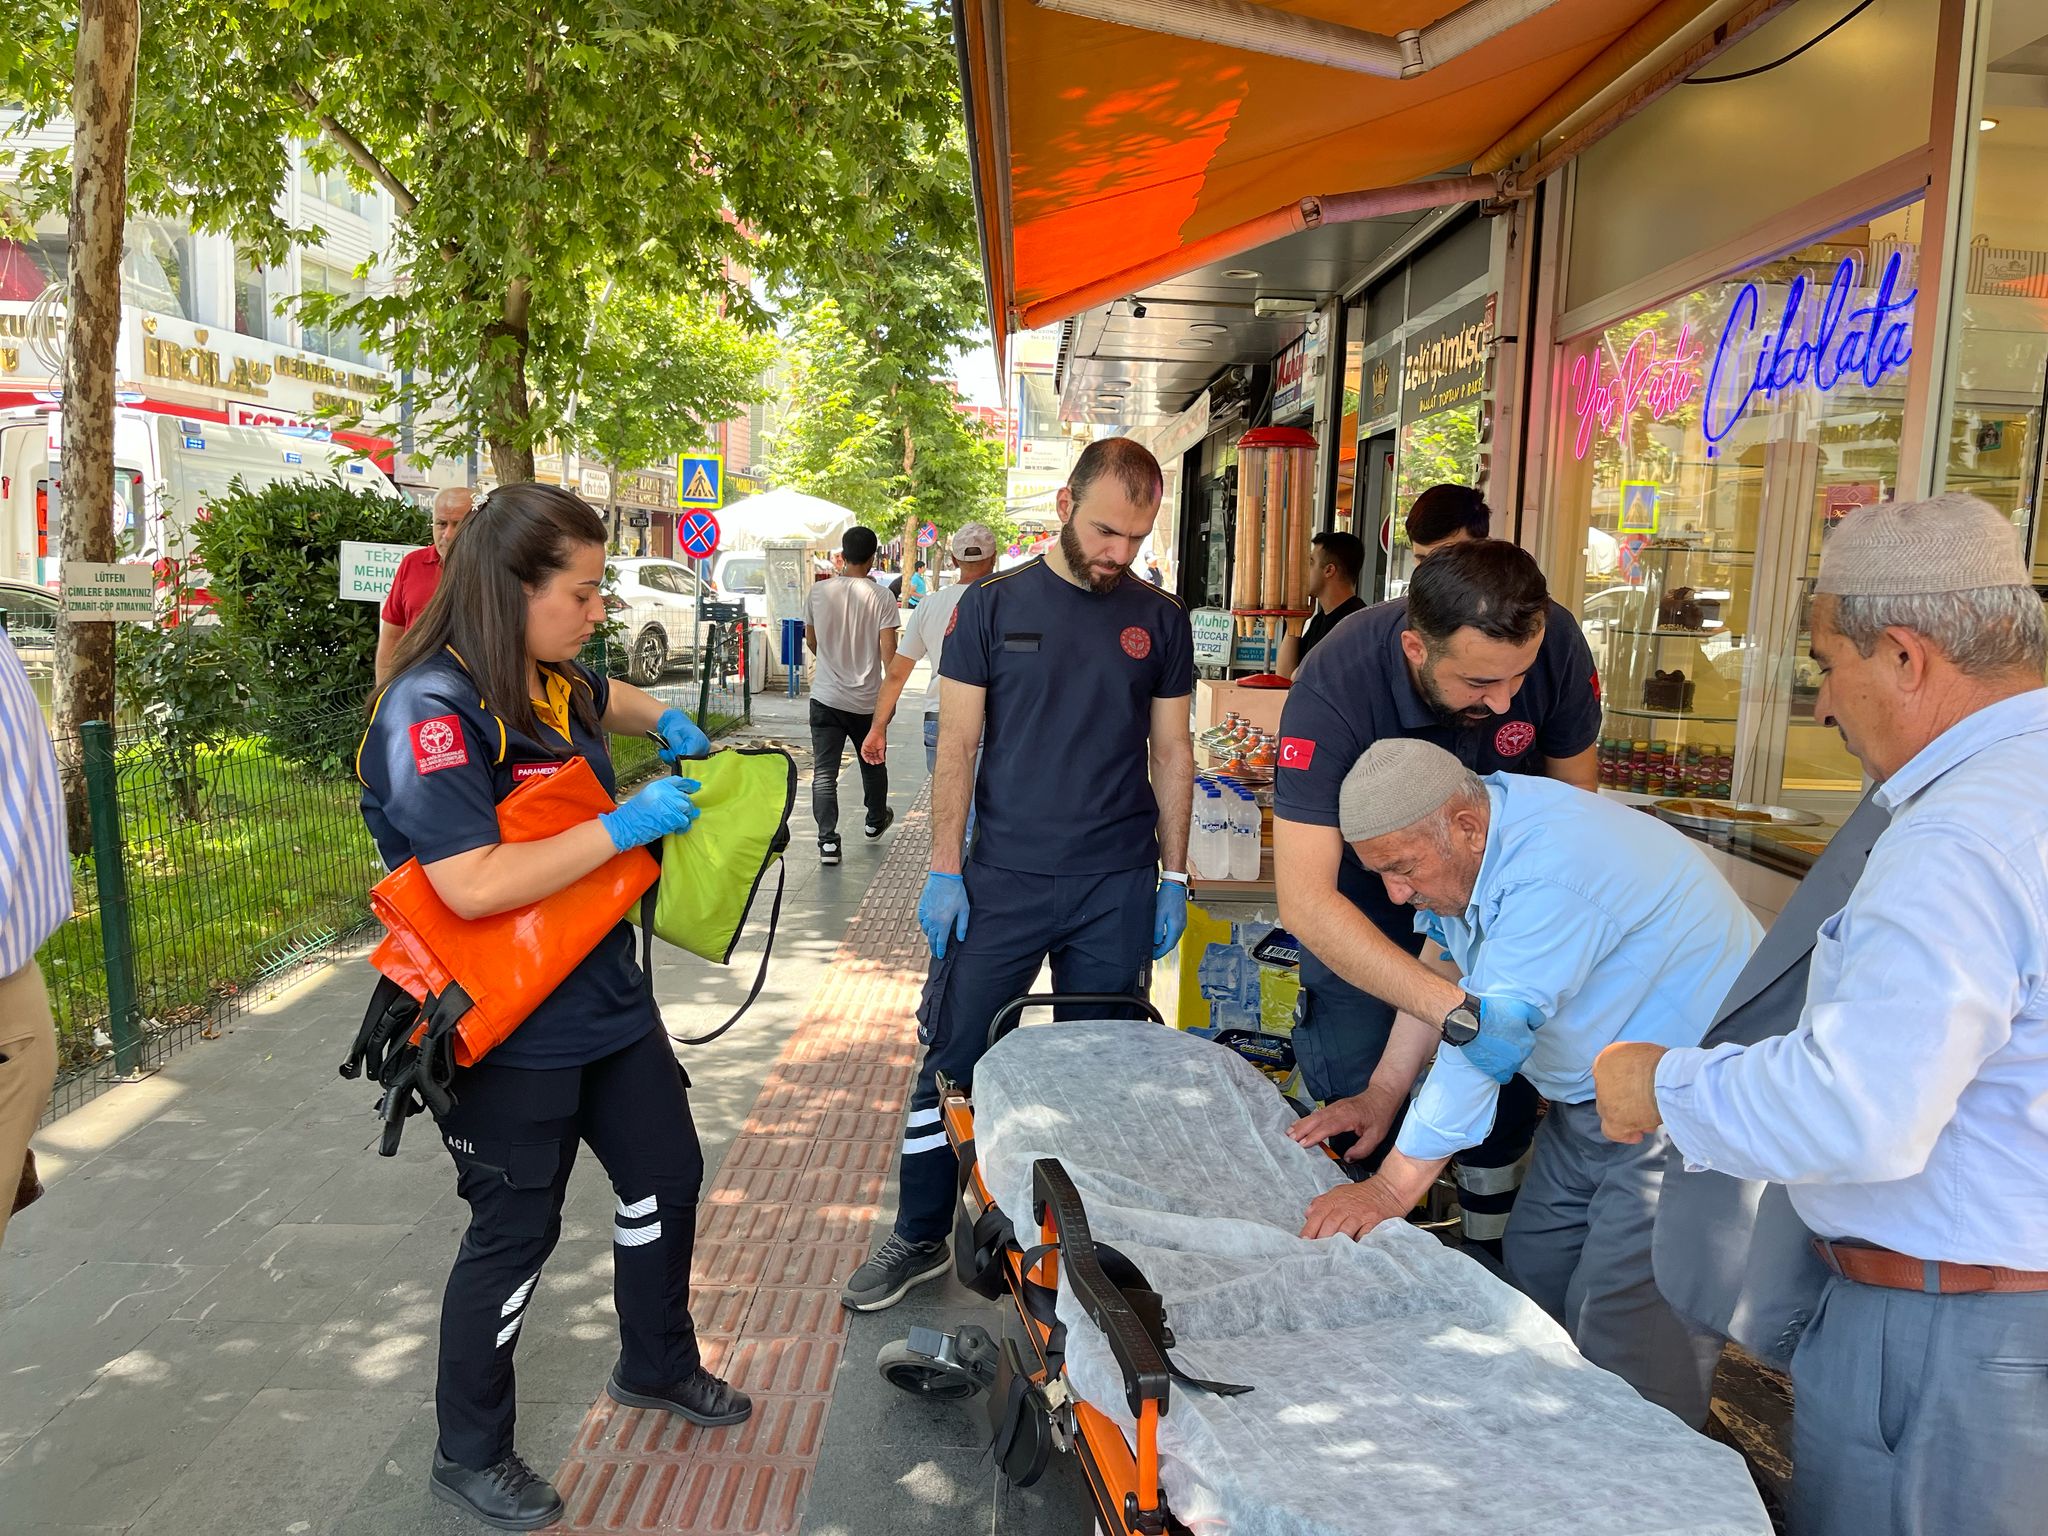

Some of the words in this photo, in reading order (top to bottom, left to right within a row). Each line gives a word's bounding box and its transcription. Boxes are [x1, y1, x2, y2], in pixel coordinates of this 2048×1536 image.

[1619, 323, 1704, 445] Pasta
[1702, 251, 1919, 459] Çikolata
[365, 550, 405, 563] TERZİ
[95, 571, 126, 583] LÜTFEN
[354, 565, 396, 578] MEHM
[67, 585, 102, 598] ÇİMLERE
[104, 587, 152, 598] BASMAYINIZ
[68, 600, 114, 612] İZMARİT-ÇÖP
[115, 602, 153, 612] ATMAYINIZ
[1194, 614, 1230, 631] Muhip
[1192, 628, 1229, 641] TÜCCAR
[1196, 642, 1222, 653] TERZİ
[448, 1135, 476, 1155] ACİL
